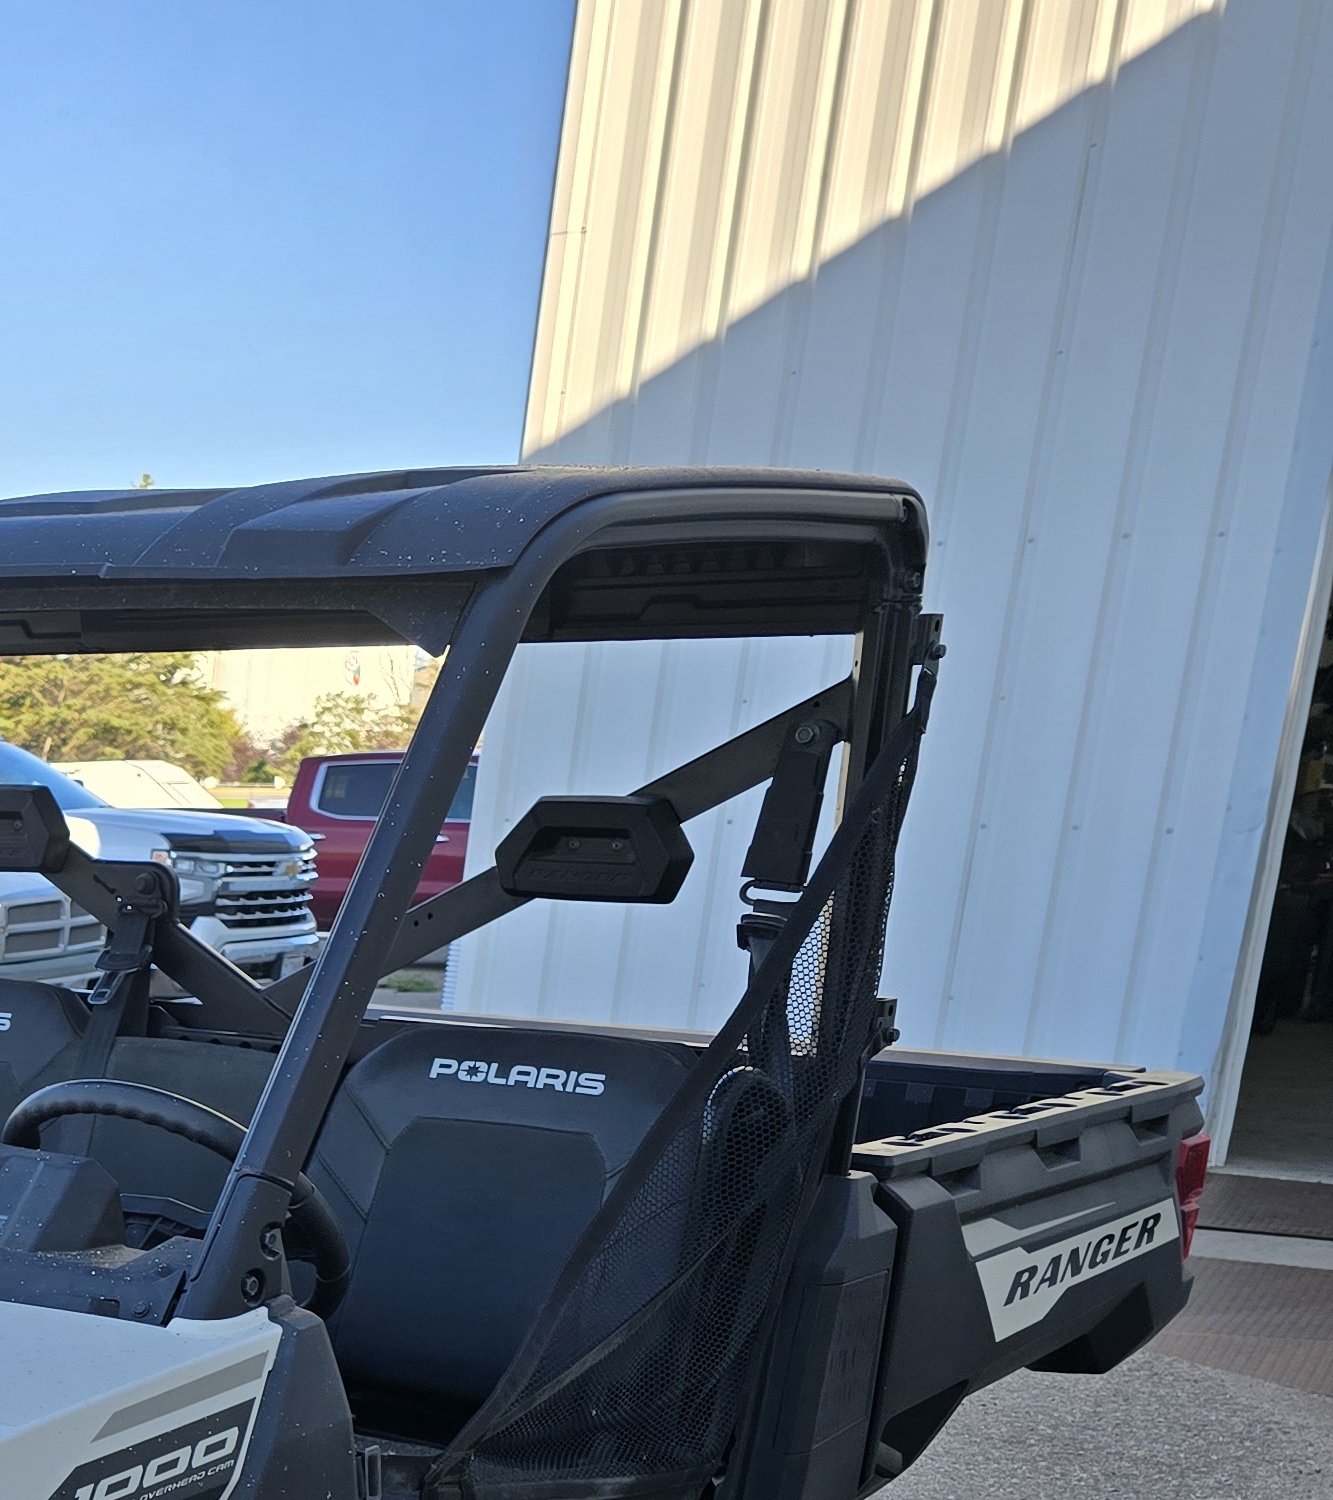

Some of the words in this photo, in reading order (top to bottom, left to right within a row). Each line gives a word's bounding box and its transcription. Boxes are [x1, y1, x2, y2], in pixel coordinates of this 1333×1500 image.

[428, 1057, 607, 1096] POLARIS
[1002, 1212, 1162, 1308] RANGER
[207, 1459, 235, 1477] CAM
